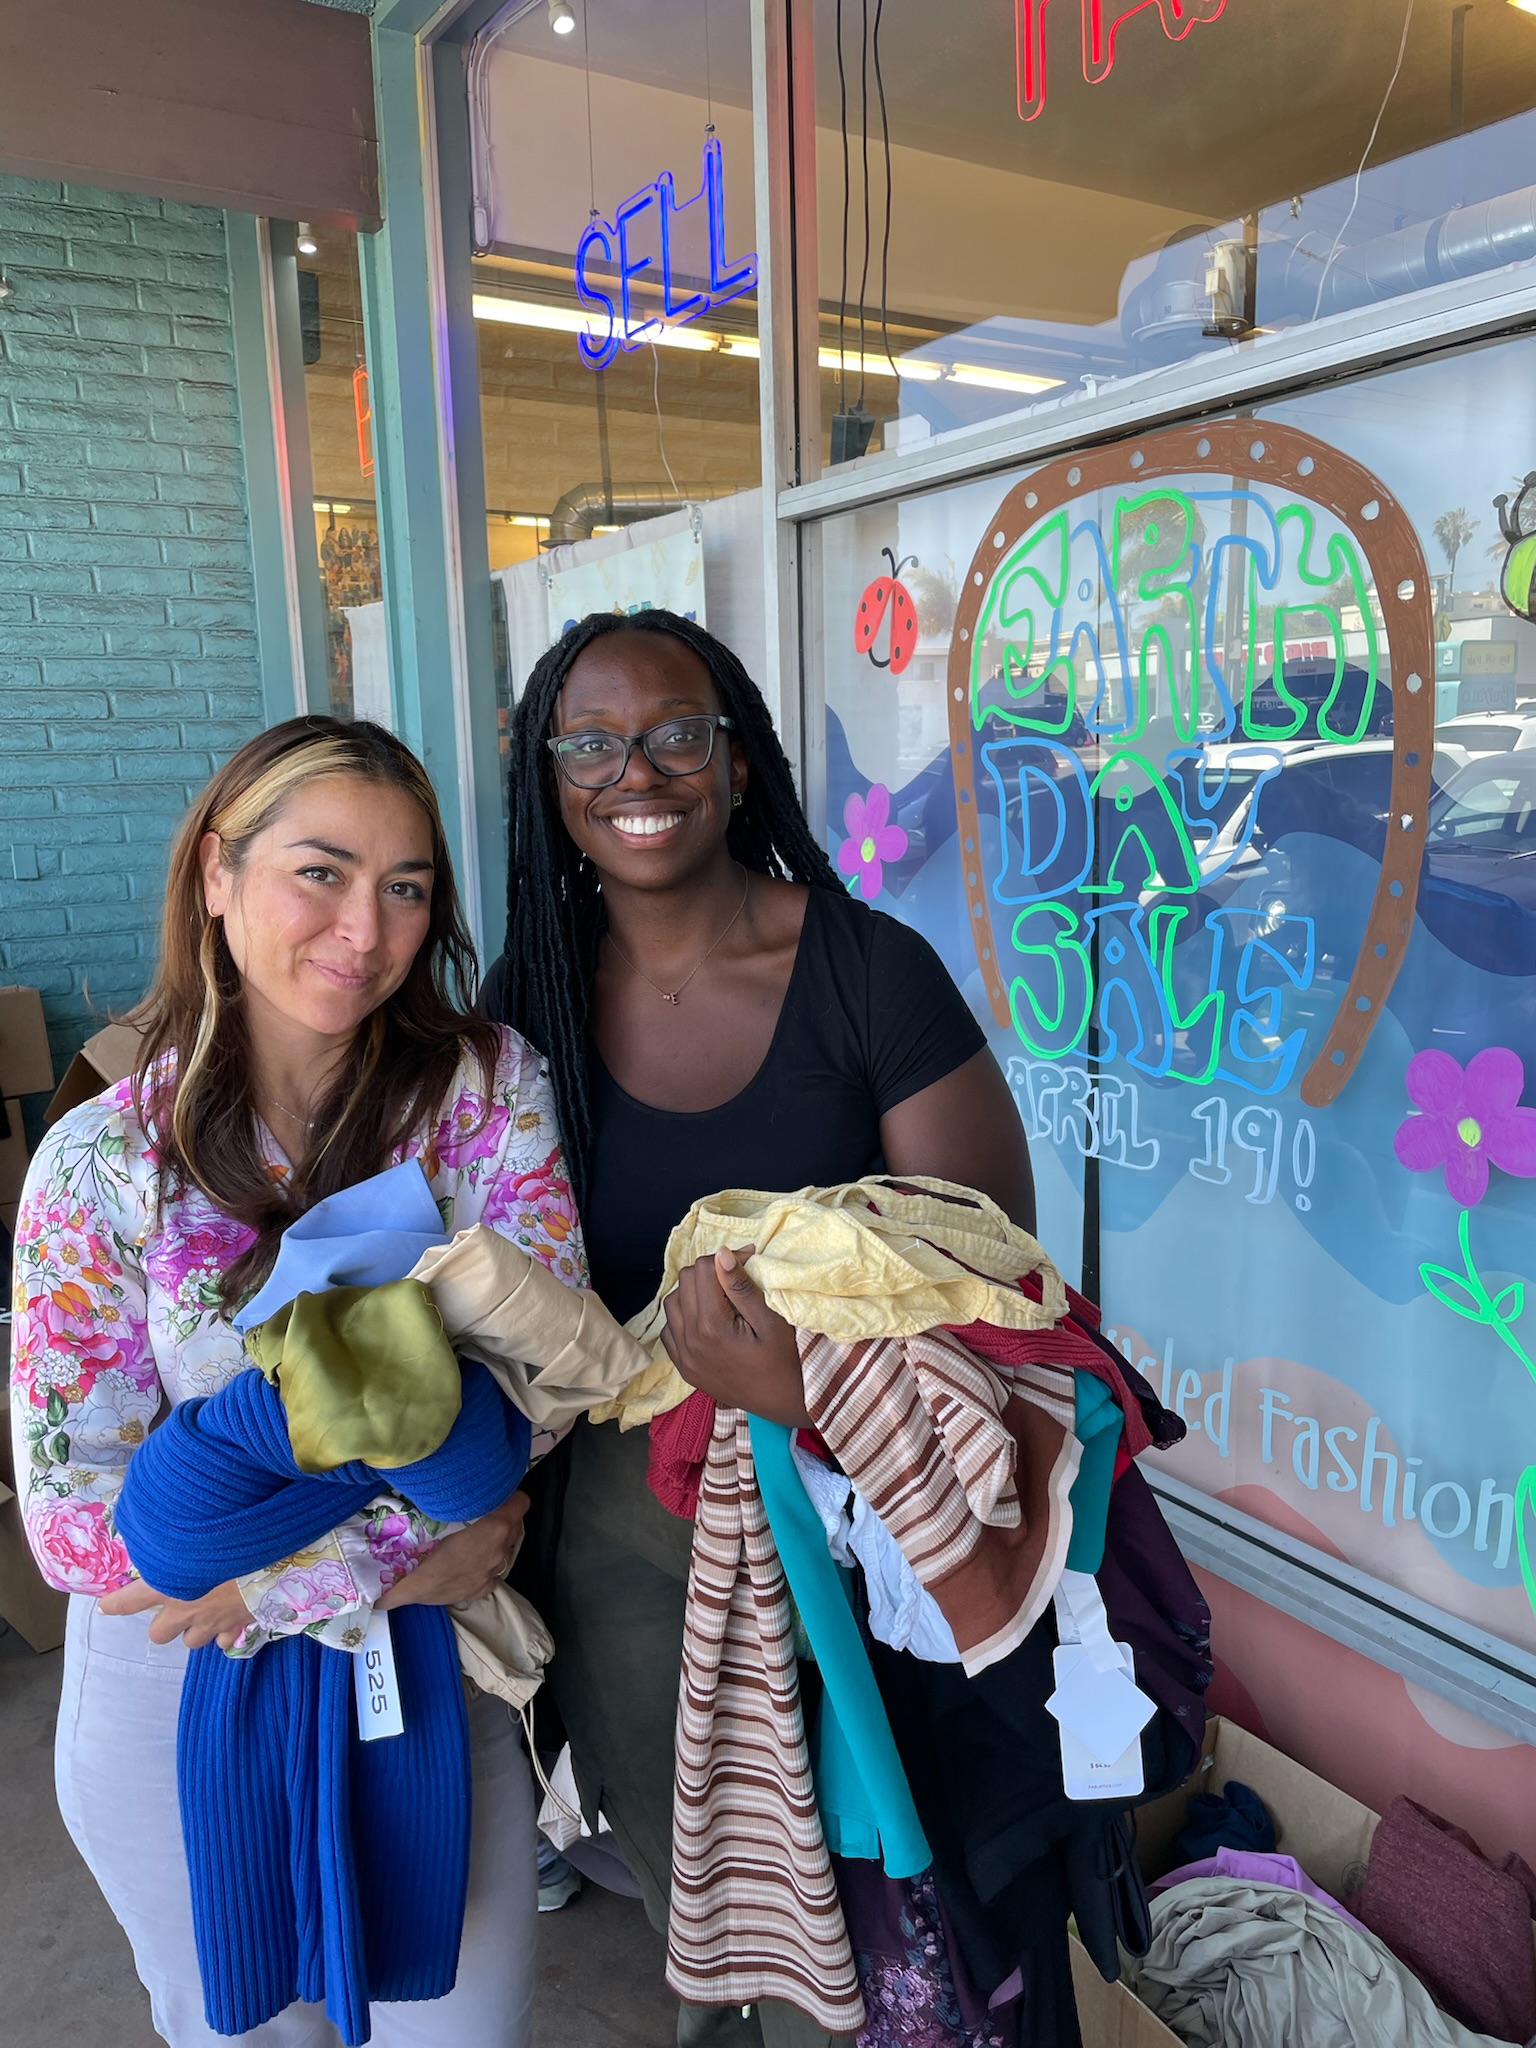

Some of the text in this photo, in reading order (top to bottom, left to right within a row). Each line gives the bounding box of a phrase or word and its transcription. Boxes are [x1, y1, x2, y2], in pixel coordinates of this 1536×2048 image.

[576, 143, 758, 368] SELL
[972, 488, 1378, 745] EARTH
[980, 736, 1284, 904] DAY
[1009, 901, 1316, 1095] SALE
[1005, 1056, 1317, 1212] APRIL 19!
[1259, 1387, 1516, 1570] Fashion
[365, 1650, 388, 1715] 525
